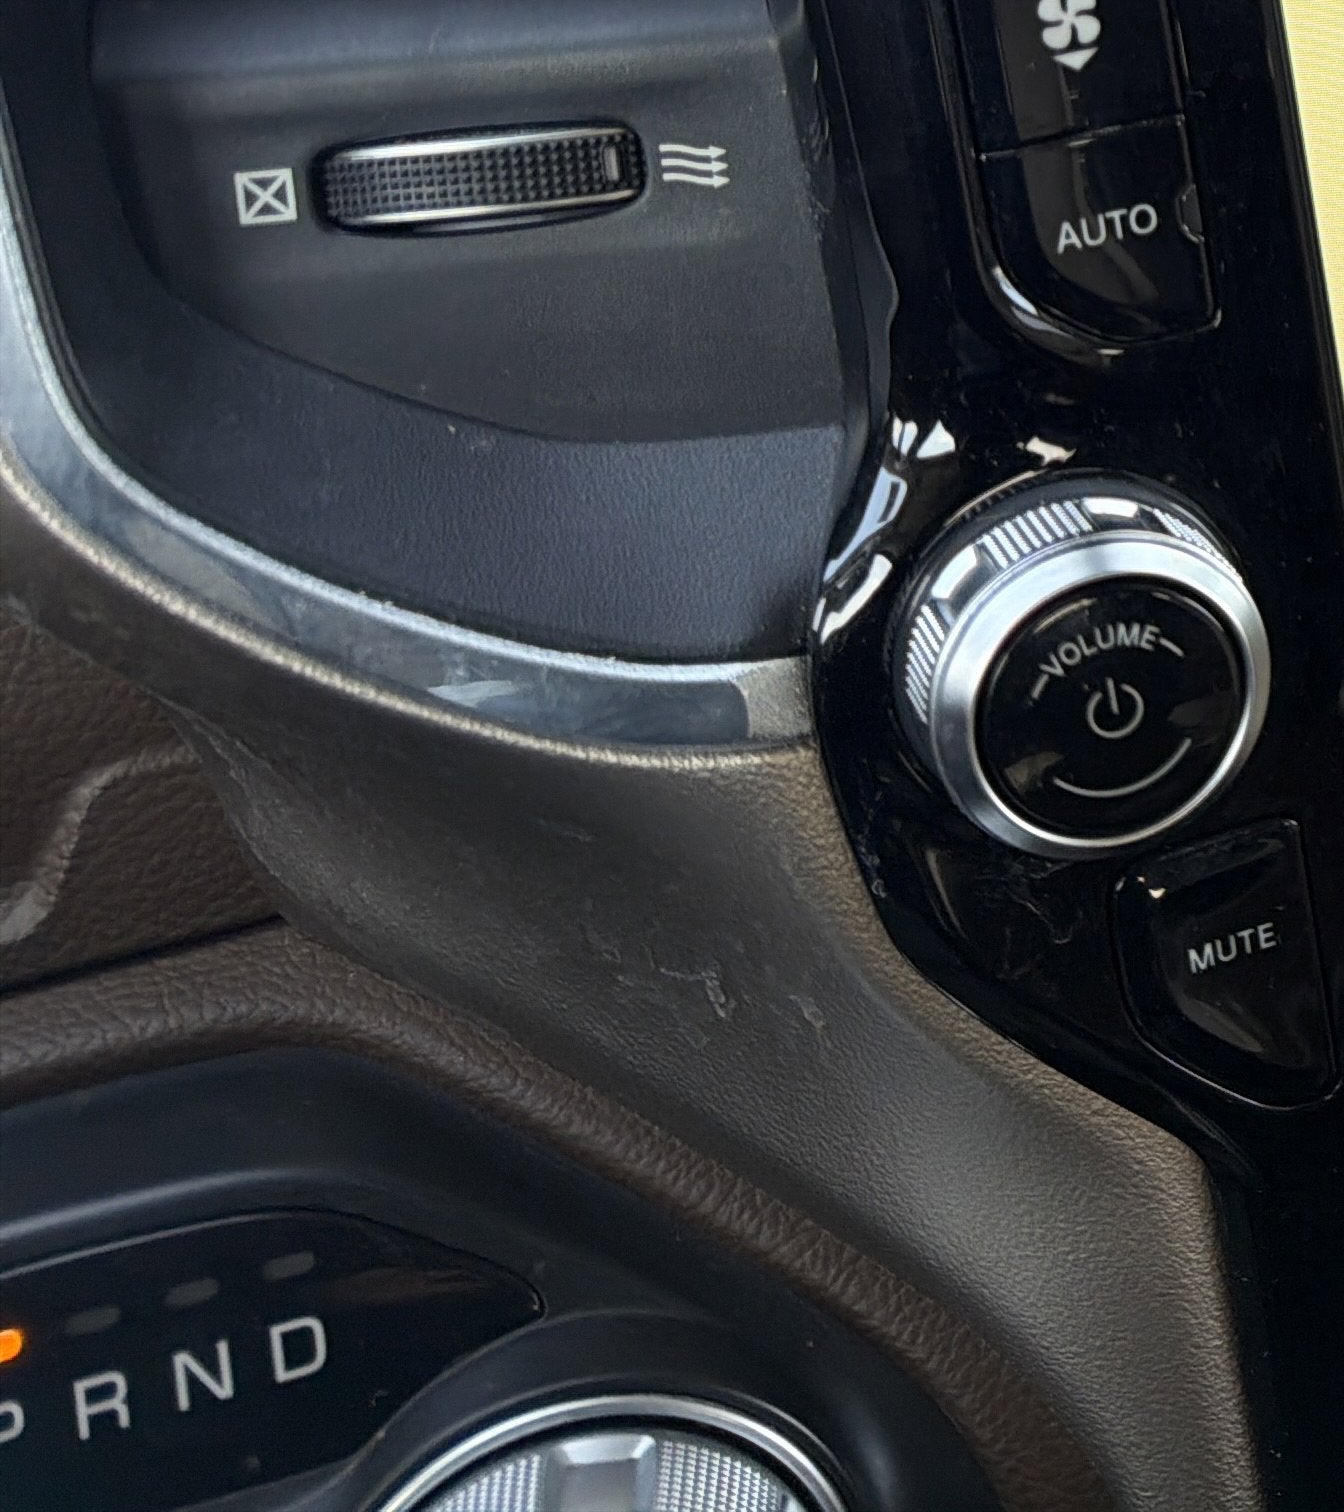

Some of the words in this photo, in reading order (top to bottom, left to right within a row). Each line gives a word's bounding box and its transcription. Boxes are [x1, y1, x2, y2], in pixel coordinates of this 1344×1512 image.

[1056, 203, 1159, 255] AUTO
[1040, 622, 1161, 679] VOLUME
[1187, 921, 1279, 975] MUTE
[73, 1371, 130, 1441] R
[173, 1339, 234, 1412] N
[269, 1316, 327, 1384] D
